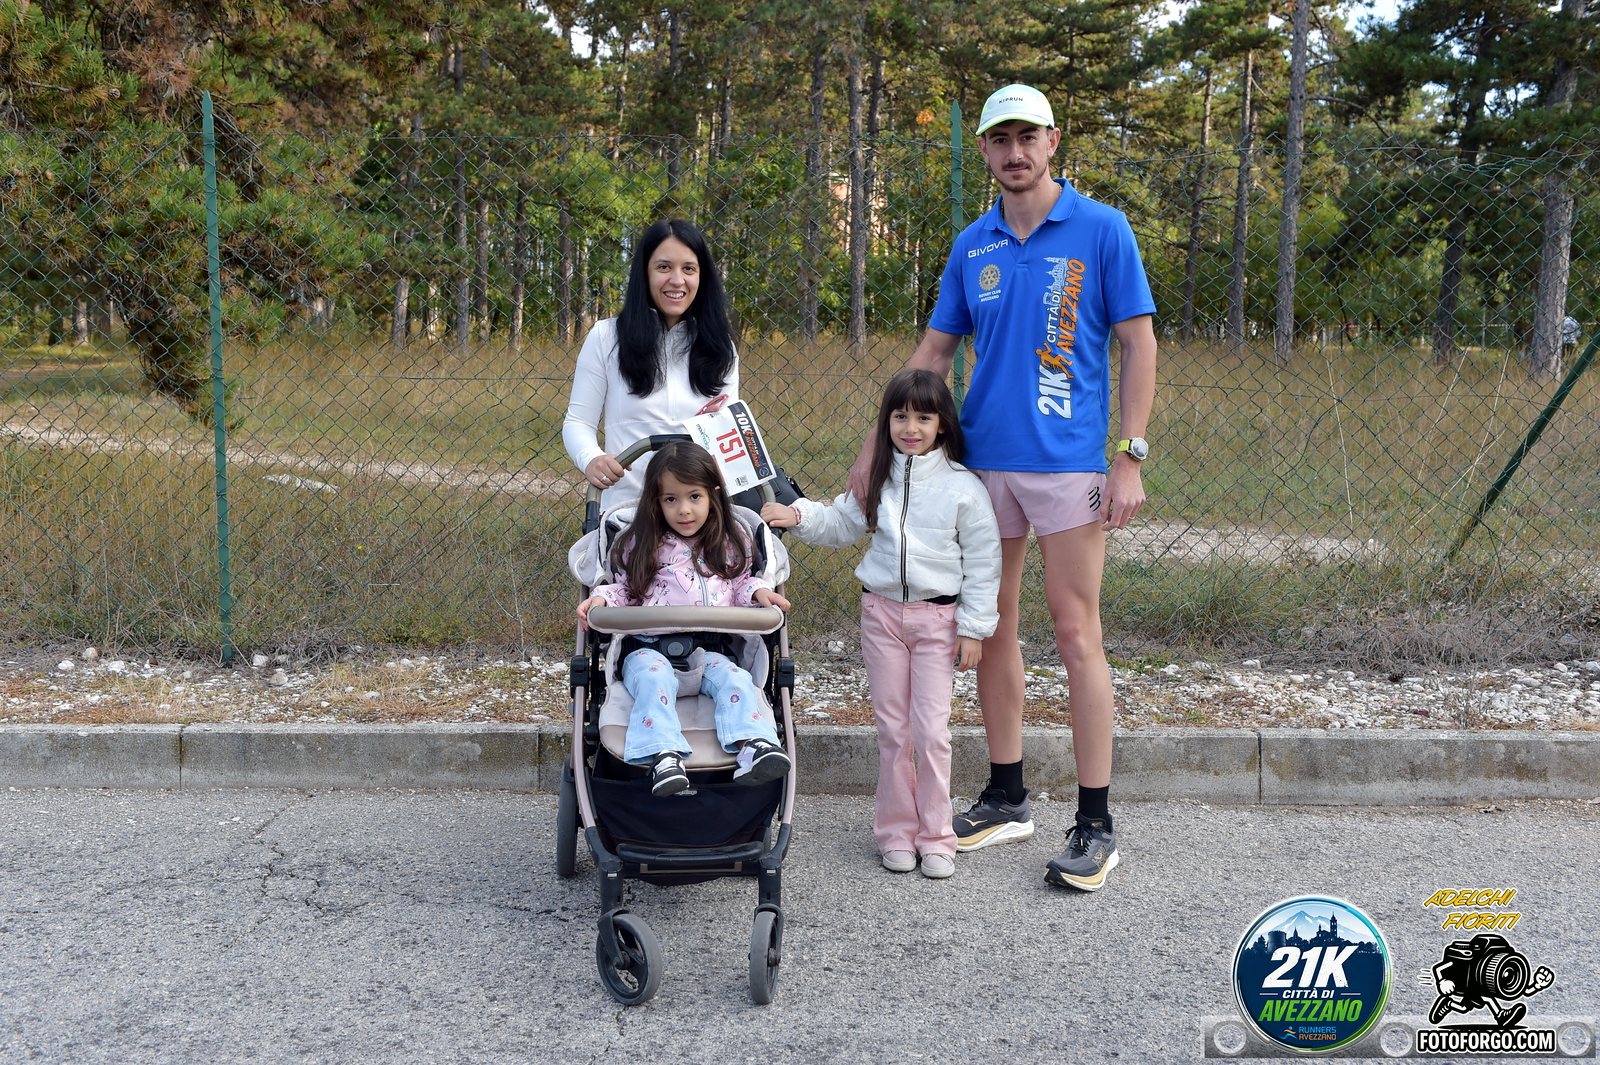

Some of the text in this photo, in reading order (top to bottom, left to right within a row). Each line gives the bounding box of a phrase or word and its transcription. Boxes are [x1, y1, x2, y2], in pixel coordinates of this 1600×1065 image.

[968, 239, 1009, 258] GIVOVA
[1046, 290, 1061, 343] CITTÀ DI
[1056, 258, 1086, 355] AVEZZANO
[1037, 365, 1072, 419] 21K
[736, 412, 754, 434] 10K
[716, 428, 746, 463] 151
